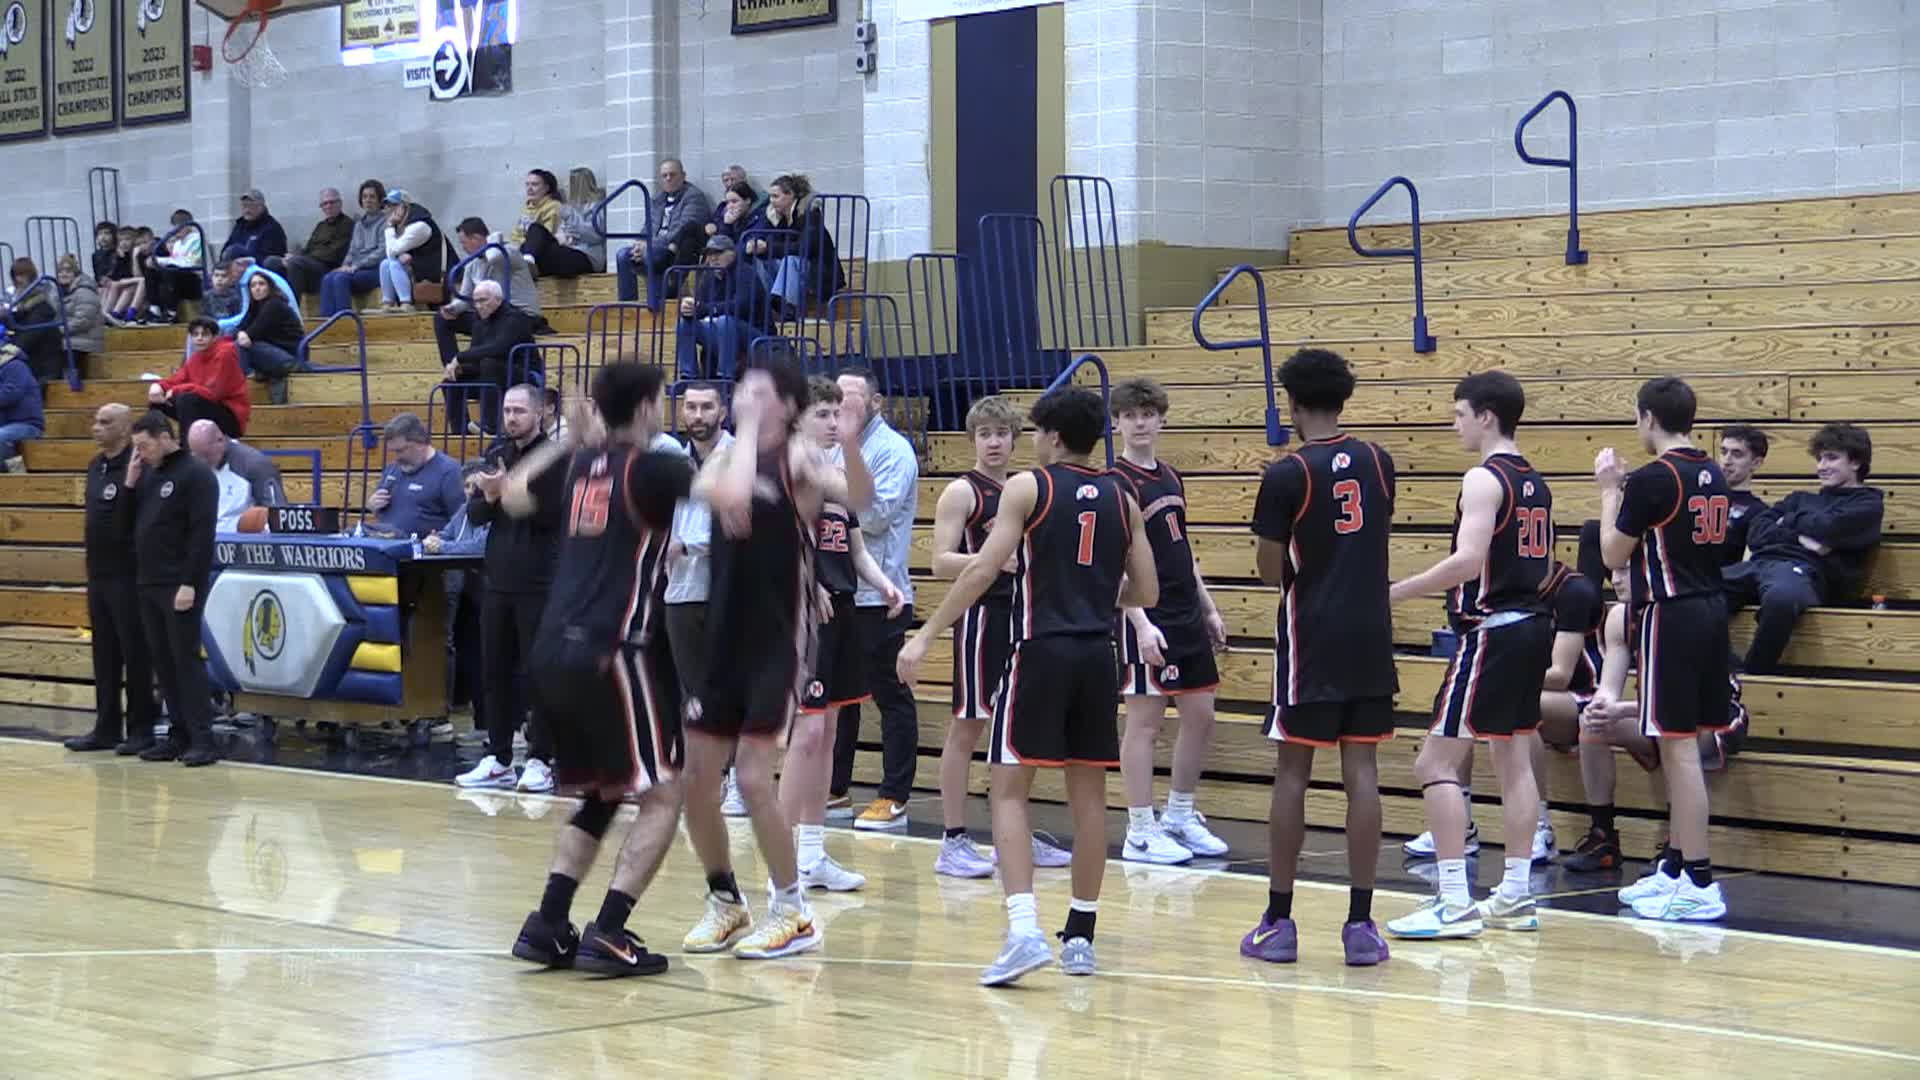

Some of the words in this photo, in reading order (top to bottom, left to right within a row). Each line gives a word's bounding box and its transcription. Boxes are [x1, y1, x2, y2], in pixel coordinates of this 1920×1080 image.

[142, 46, 166, 62] 2023
[72, 58, 94, 74] 2022
[127, 69, 158, 84] WINTER
[159, 65, 181, 80] STATE
[57, 78, 87, 96] WINTER
[88, 76, 109, 92] STATE
[127, 86, 182, 107] CHAMPIONS
[0, 106, 40, 124] AMPIONS
[57, 97, 110, 117] CHAMPIONS
[1332, 479, 1363, 534] 3
[1688, 495, 1728, 544] 30
[817, 519, 849, 552] 22
[1077, 511, 1097, 566] 1
[1516, 507, 1547, 558] 20
[217, 543, 236, 564] OF
[241, 543, 275, 564] THE
[280, 545, 366, 569] WARRIORS
